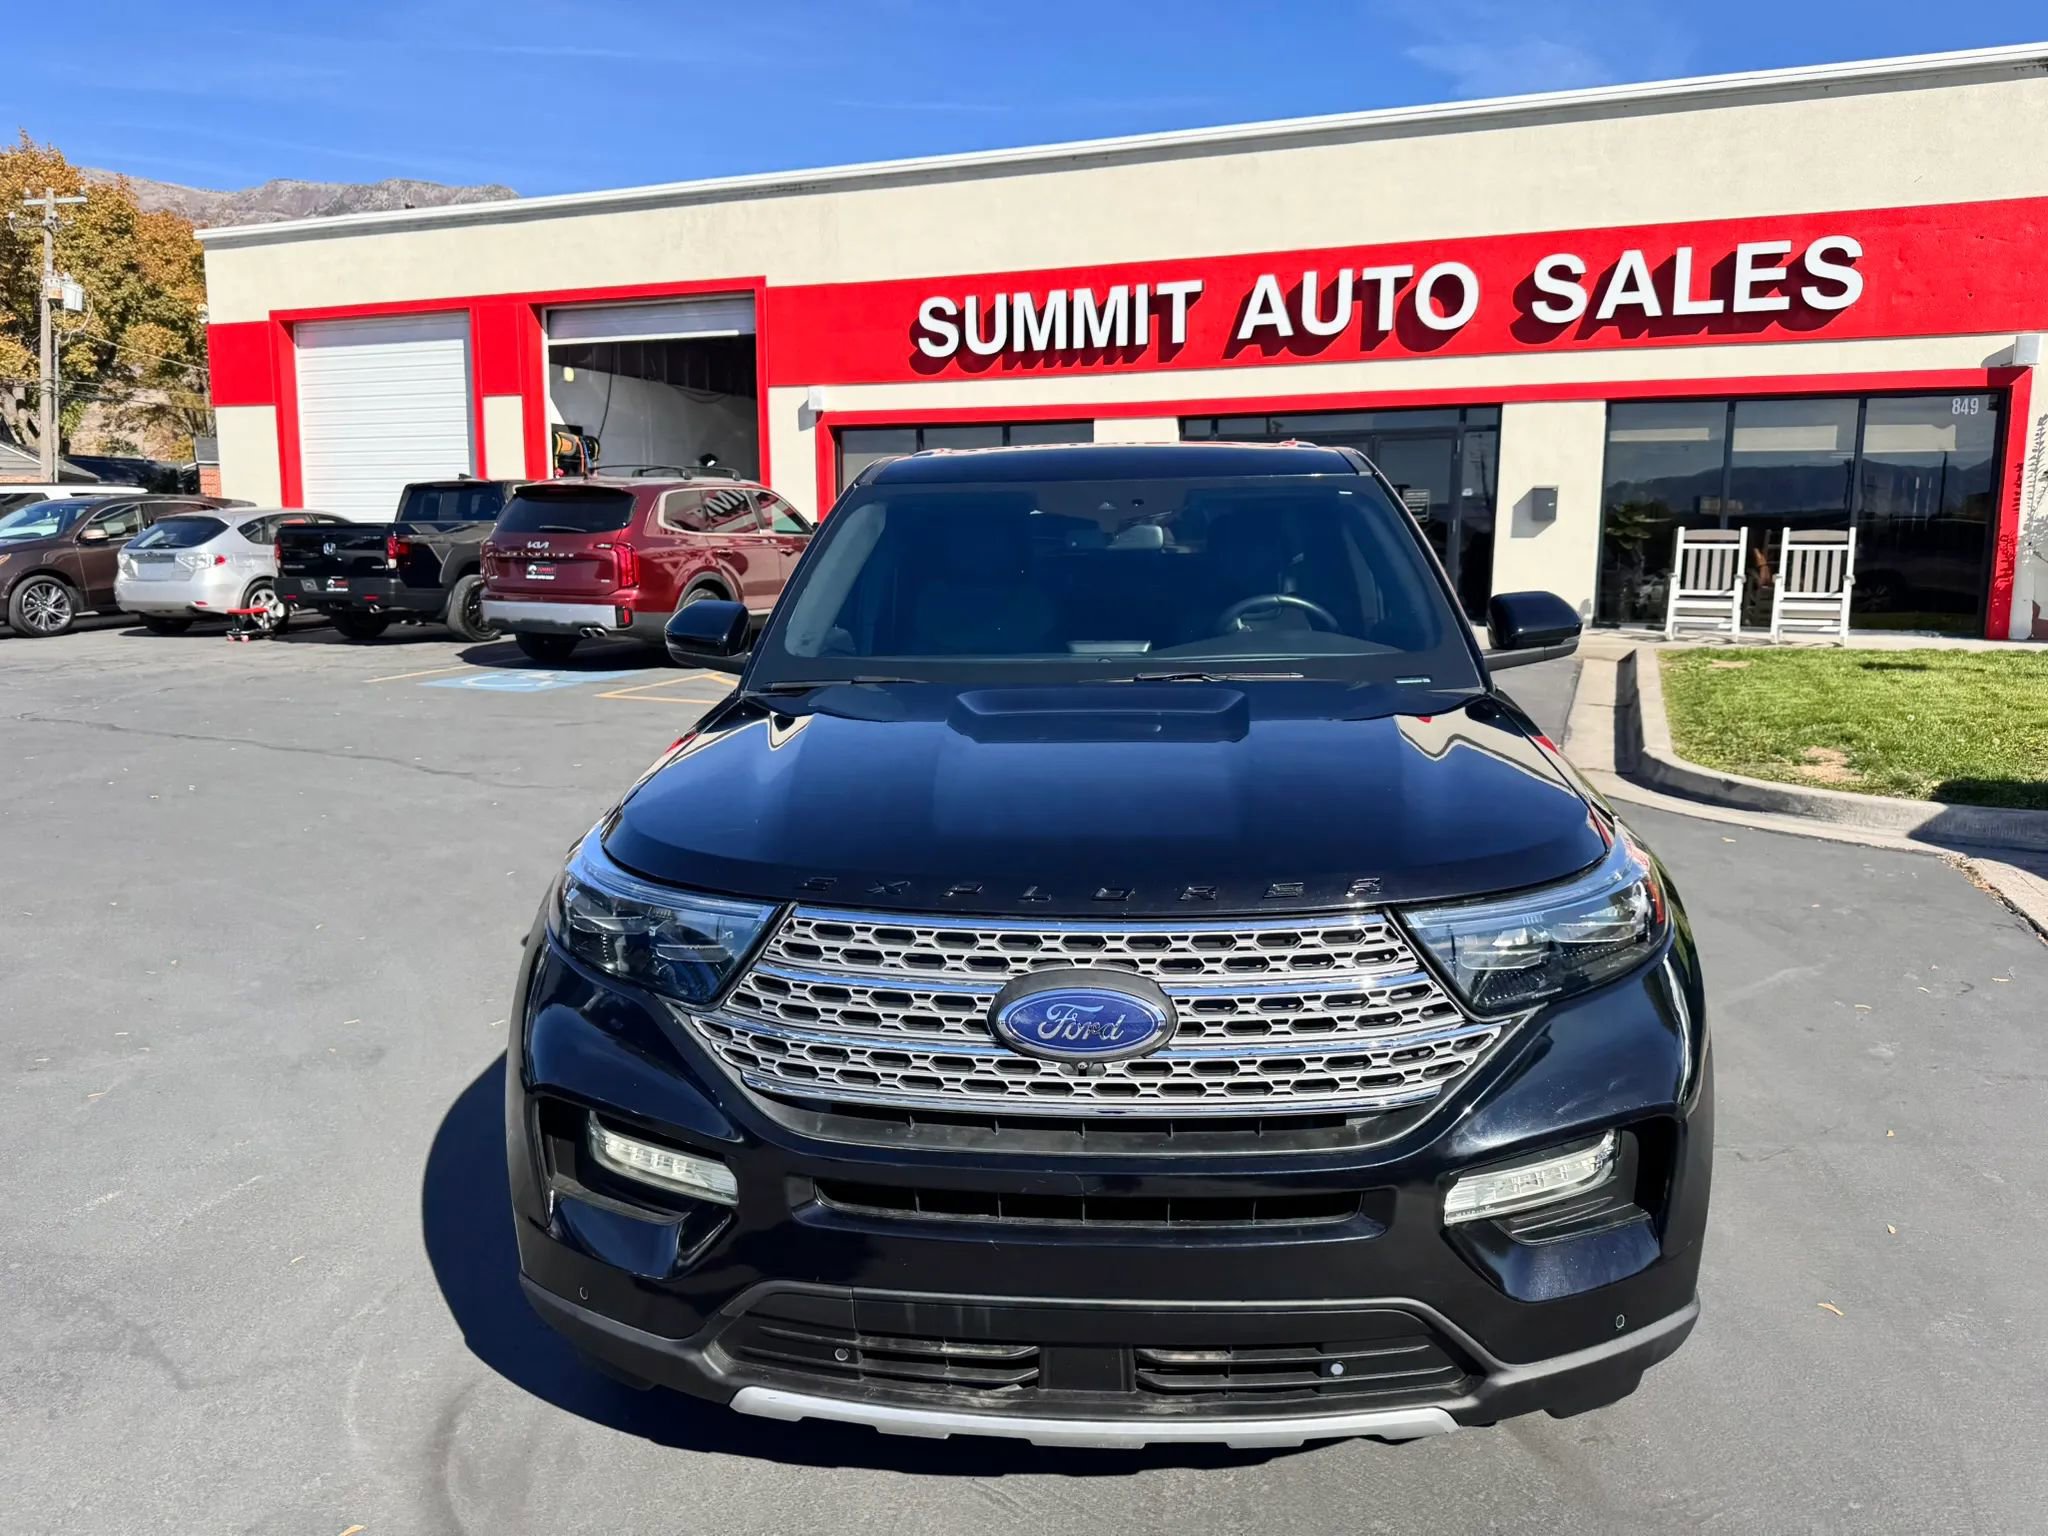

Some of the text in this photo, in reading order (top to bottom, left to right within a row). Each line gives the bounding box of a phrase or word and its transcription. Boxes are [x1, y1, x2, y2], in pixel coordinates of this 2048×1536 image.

[917, 235, 1864, 358] SUMMIT AUTO SALES
[1951, 397, 1979, 415] 849
[796, 876, 1381, 901] EXPLORER
[1037, 1003, 1127, 1041] Ford
